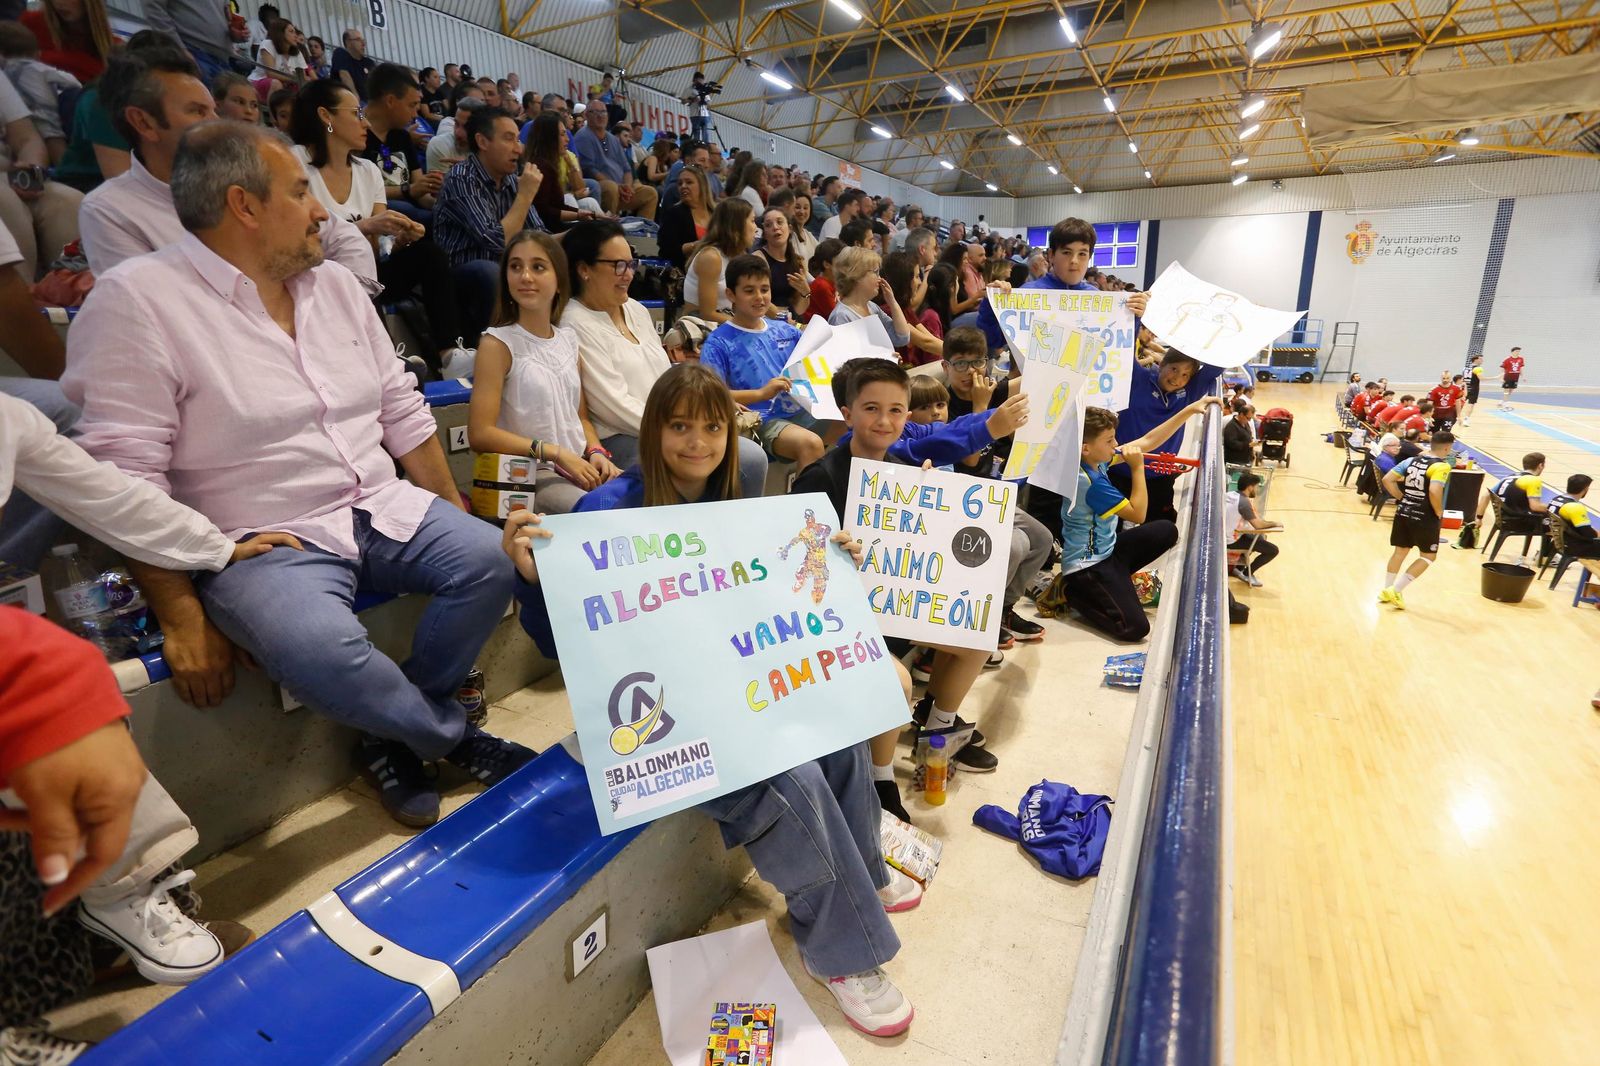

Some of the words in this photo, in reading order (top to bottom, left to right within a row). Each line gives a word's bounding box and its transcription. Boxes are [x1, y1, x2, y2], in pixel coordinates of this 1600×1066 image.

[370, 0, 385, 28] B
[1377, 246, 1391, 256] de
[1394, 245, 1459, 258] Algeciras
[1379, 234, 1461, 246] Ayuntamiento
[456, 431, 465, 445] 4
[1405, 465, 1426, 490] 25
[860, 469, 950, 512] MANEL
[962, 484, 1009, 523] 64
[582, 531, 707, 571] VAMOS
[961, 533, 987, 555] BM
[730, 608, 844, 658] VAMOS
[745, 631, 883, 712] CAMPEÓN
[605, 770, 615, 788] CLUB
[612, 741, 711, 786] BALONMANO
[610, 783, 637, 798] CIUDAD
[636, 759, 715, 799] ALGECIRAS
[584, 931, 598, 961] 2
